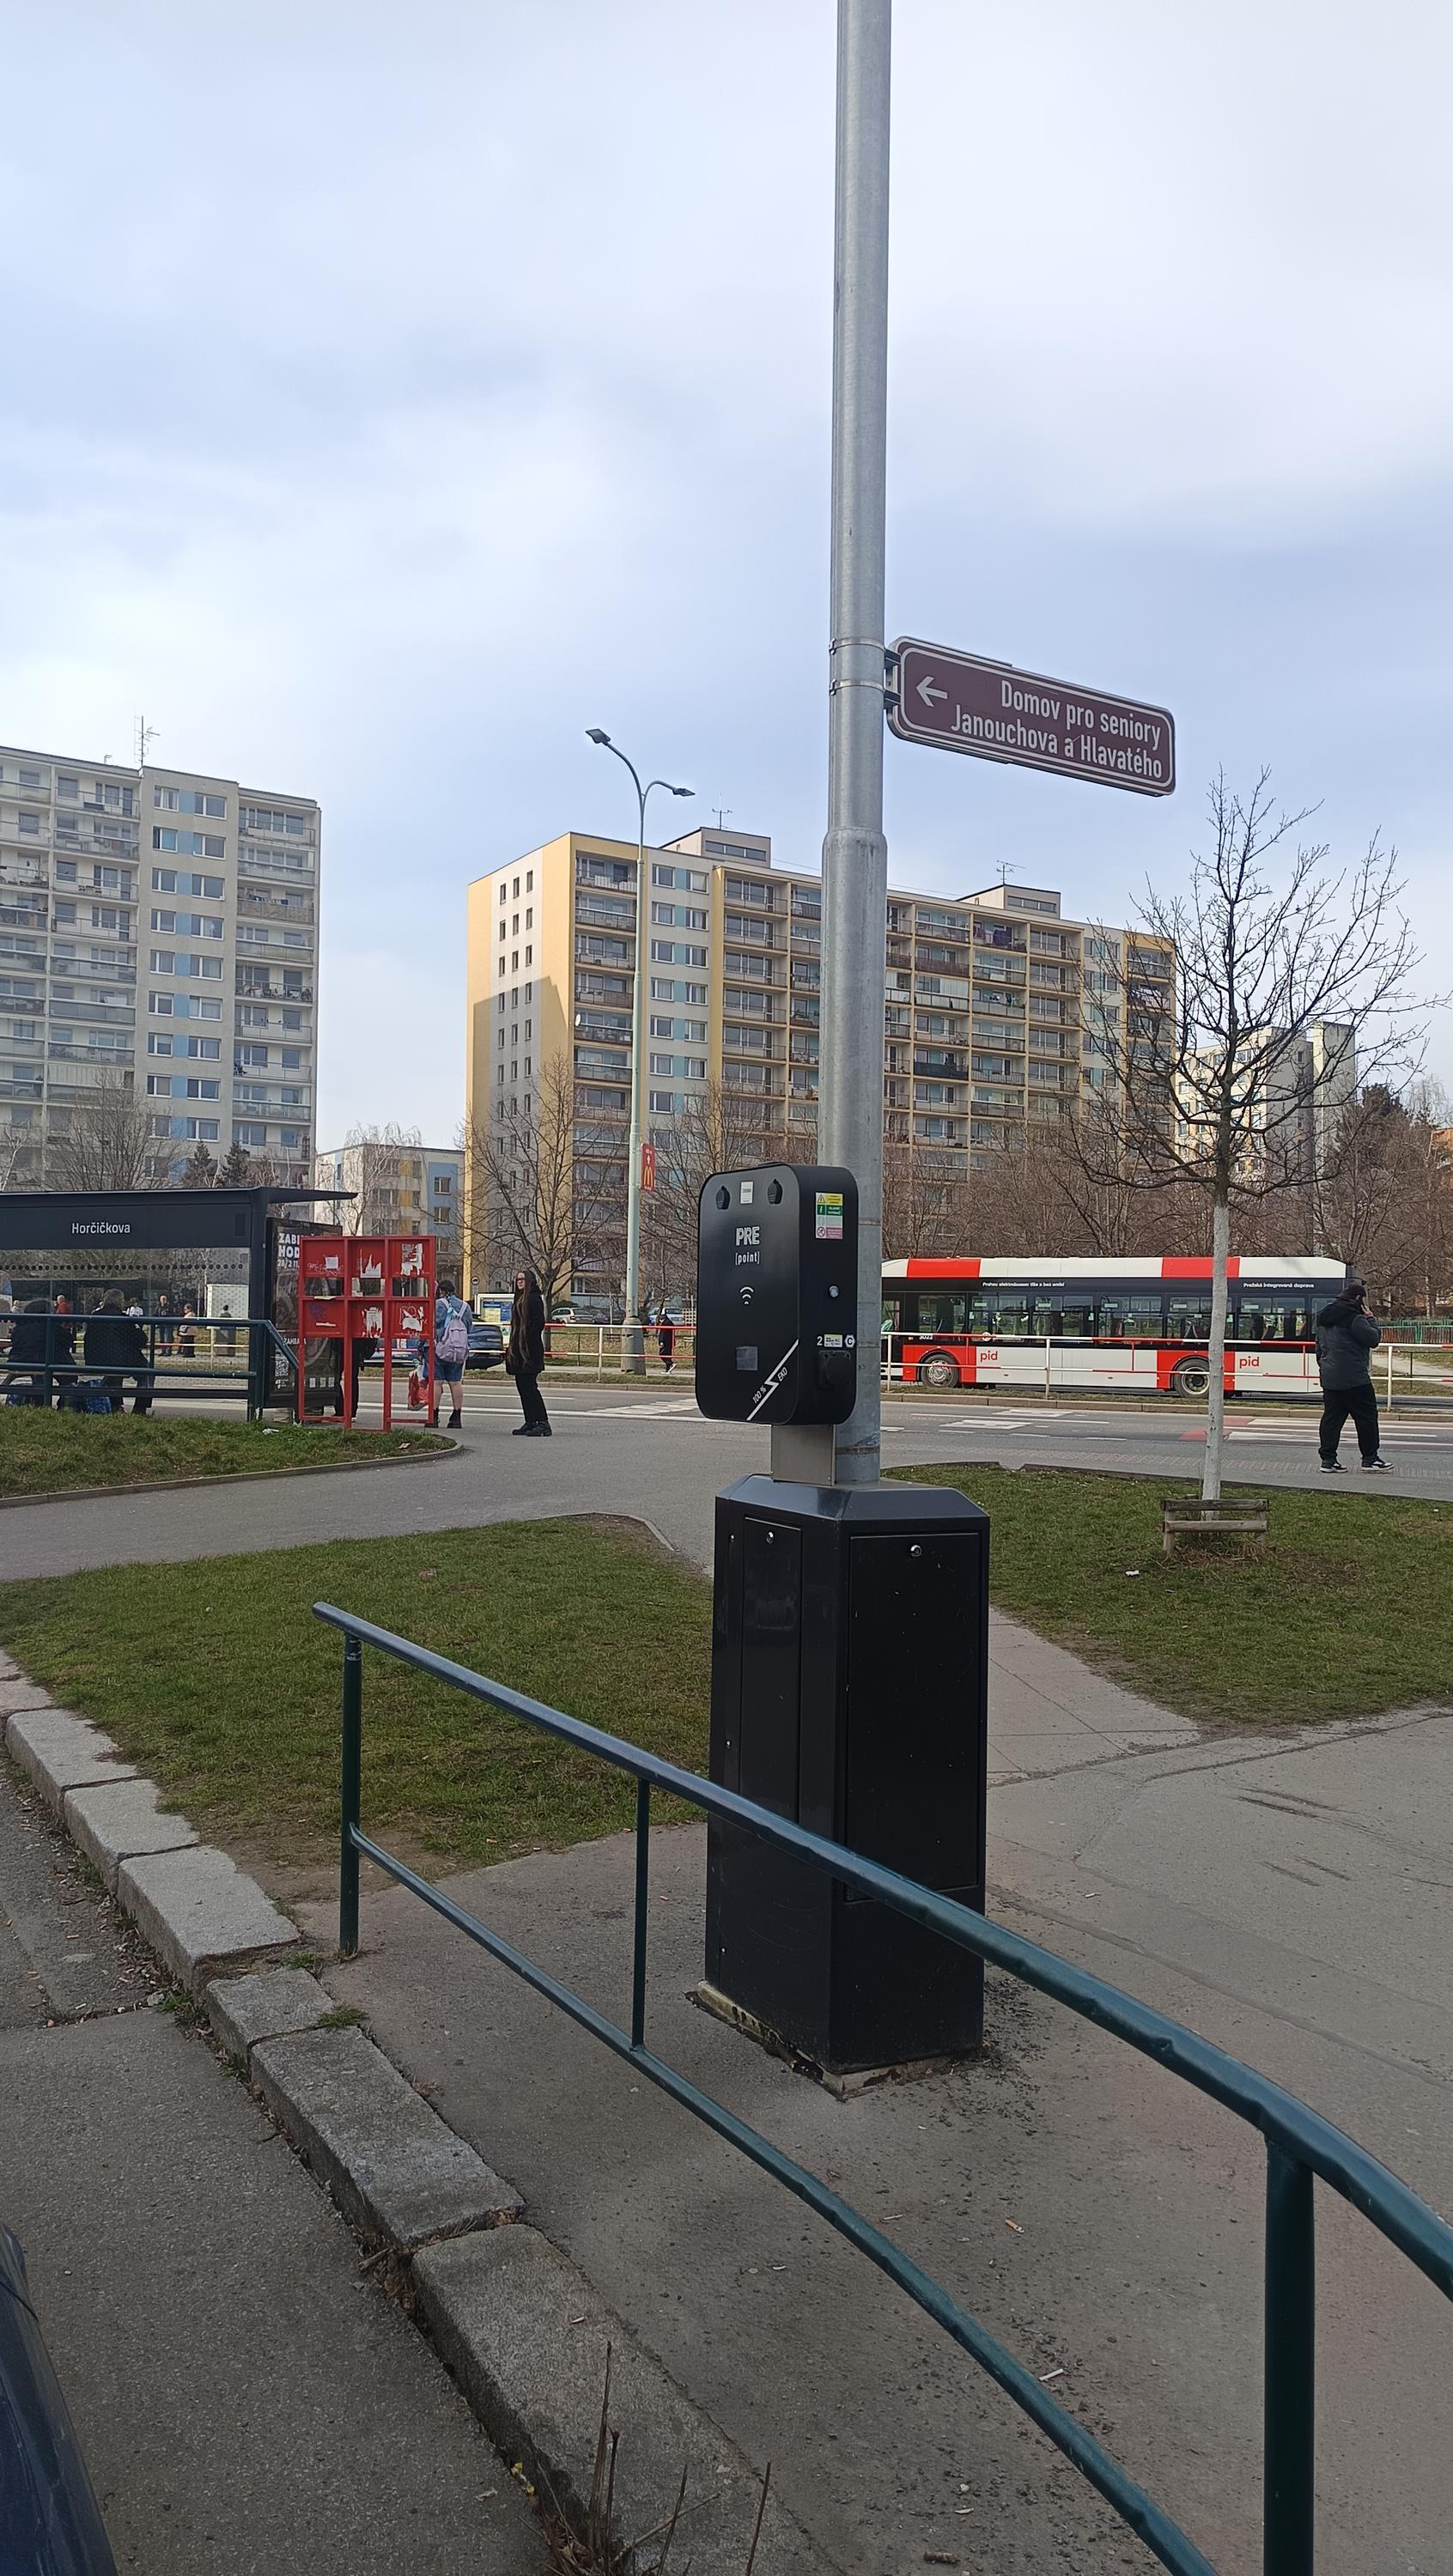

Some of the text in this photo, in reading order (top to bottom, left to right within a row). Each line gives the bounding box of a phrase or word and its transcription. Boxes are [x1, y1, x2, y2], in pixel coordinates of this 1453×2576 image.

[1001, 679, 1161, 751] Domov pro seniory
[951, 704, 1163, 779] Janouchova a Hlavatého
[71, 1222, 131, 1234] Horčičkova
[278, 1232, 301, 1245] ZABI
[736, 1226, 760, 1246] PRE
[277, 1244, 301, 1259] HOD
[817, 1335, 823, 1346] 2
[847, 1337, 853, 1346] C
[980, 1350, 998, 1362] pid
[1239, 1355, 1260, 1369] pid
[777, 1366, 788, 1382] EKO
[752, 1390, 762, 1404] 100
